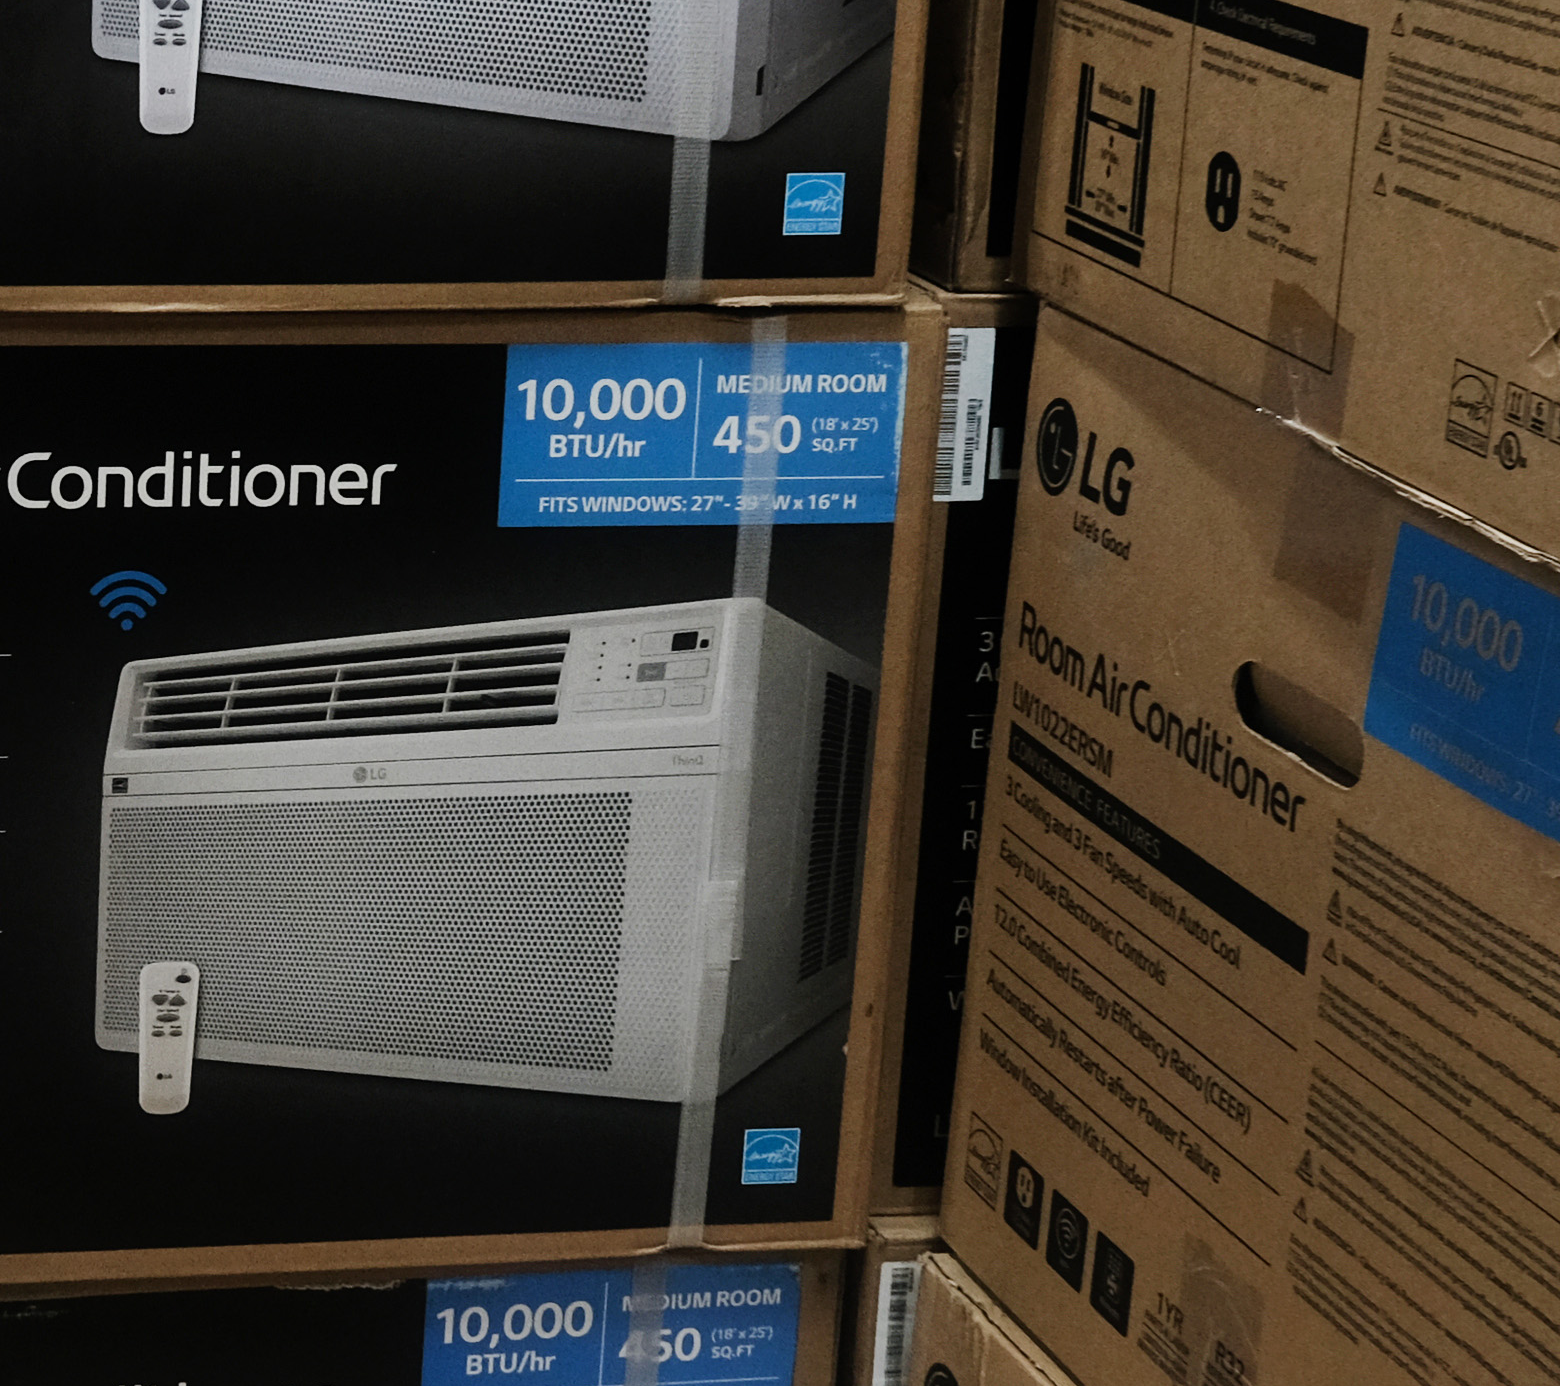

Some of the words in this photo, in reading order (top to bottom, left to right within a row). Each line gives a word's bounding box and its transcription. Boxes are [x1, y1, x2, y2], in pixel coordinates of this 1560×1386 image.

[516, 377, 687, 429] 10,000
[717, 374, 812, 394] MEDIUM
[817, 374, 887, 393] ROOM
[548, 433, 646, 459] BTU/hr
[712, 414, 801, 454] 450
[1078, 431, 1136, 517] LG
[1070, 509, 1100, 546] Life's
[1101, 528, 1132, 563] Good
[1018, 600, 1085, 692] Room
[1408, 573, 1526, 674] 10,000
[1012, 680, 1114, 779] LW1022ERSM
[715, 1288, 782, 1308] ROOM
[436, 1300, 594, 1350] 10,000
[465, 1351, 557, 1376] BTU/hr
